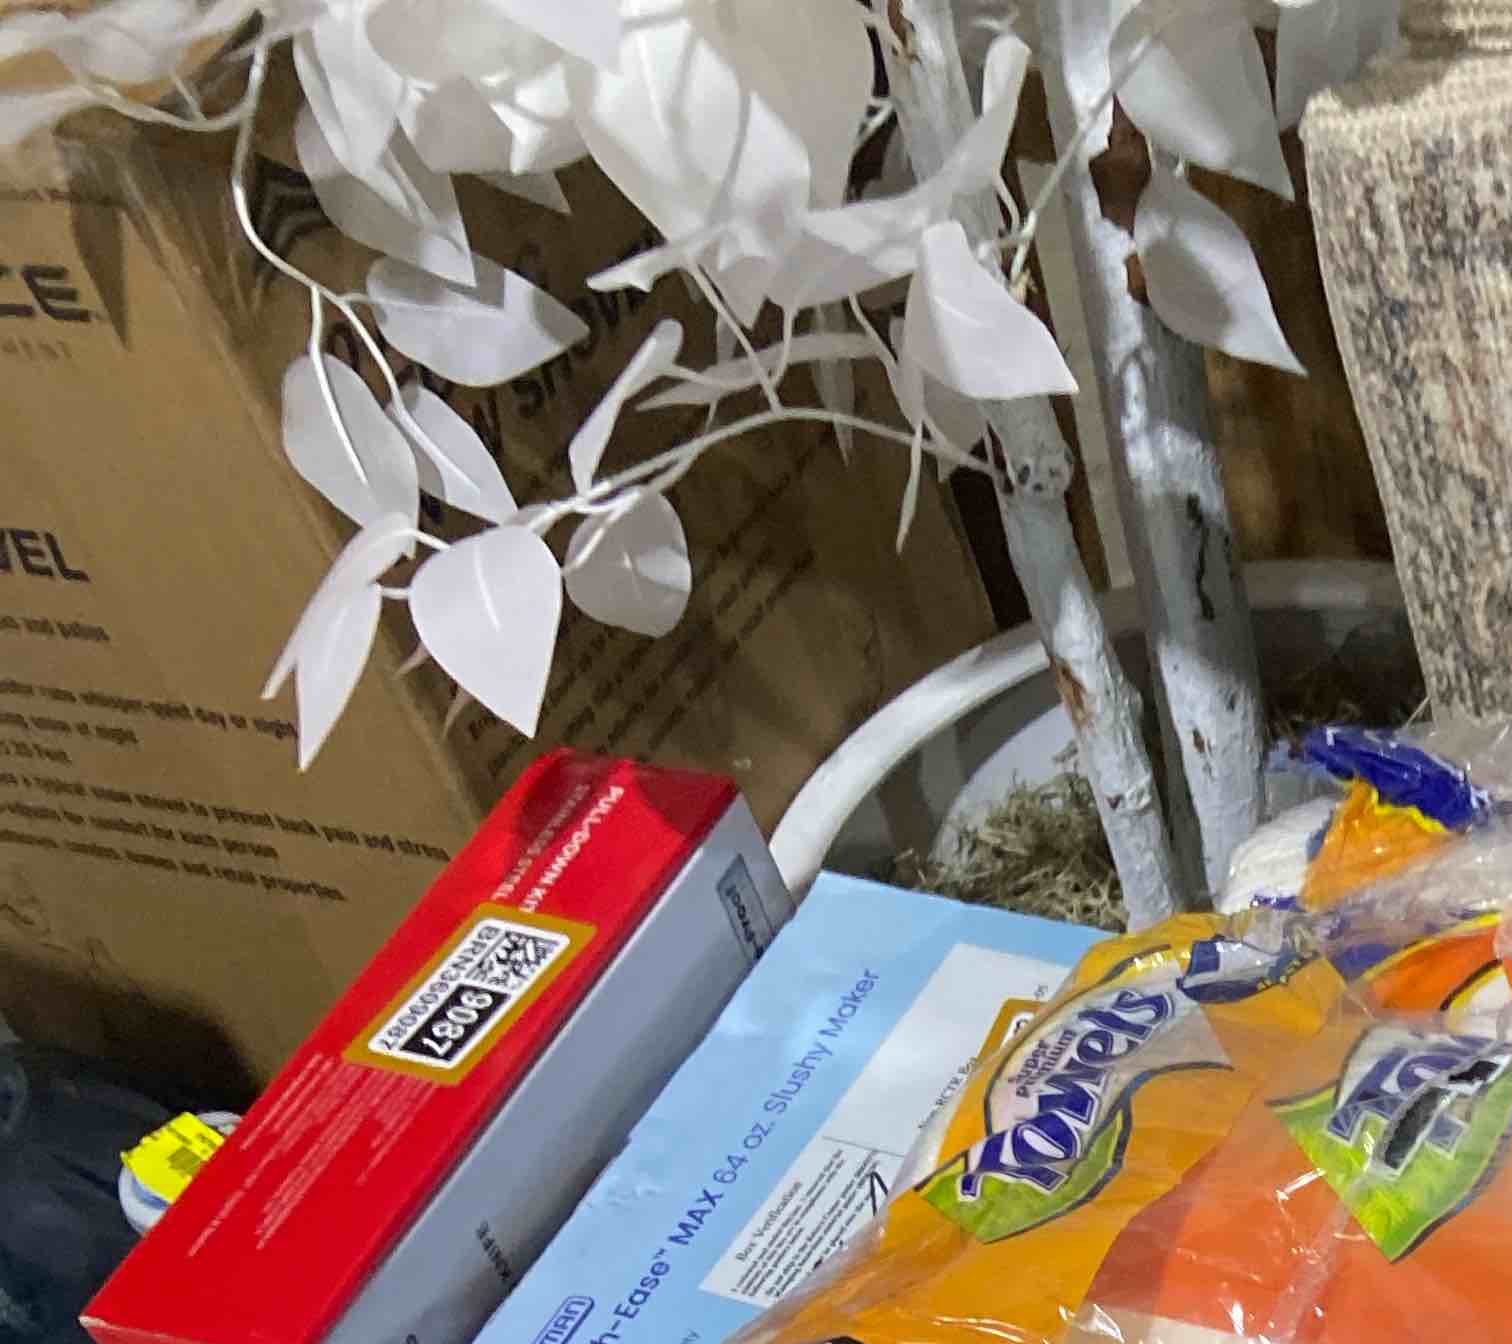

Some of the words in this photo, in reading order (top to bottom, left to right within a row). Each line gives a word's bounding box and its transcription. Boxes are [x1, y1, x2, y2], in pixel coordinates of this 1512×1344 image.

[420, 987, 494, 1059] 9087
[668, 1187, 723, 1249] MAX
[719, 1150, 748, 1187] 64
[744, 1119, 775, 1155] oz.
[763, 1035, 835, 1117] Slushy
[824, 969, 881, 1044] Maker
[958, 989, 1175, 1202] Towels
